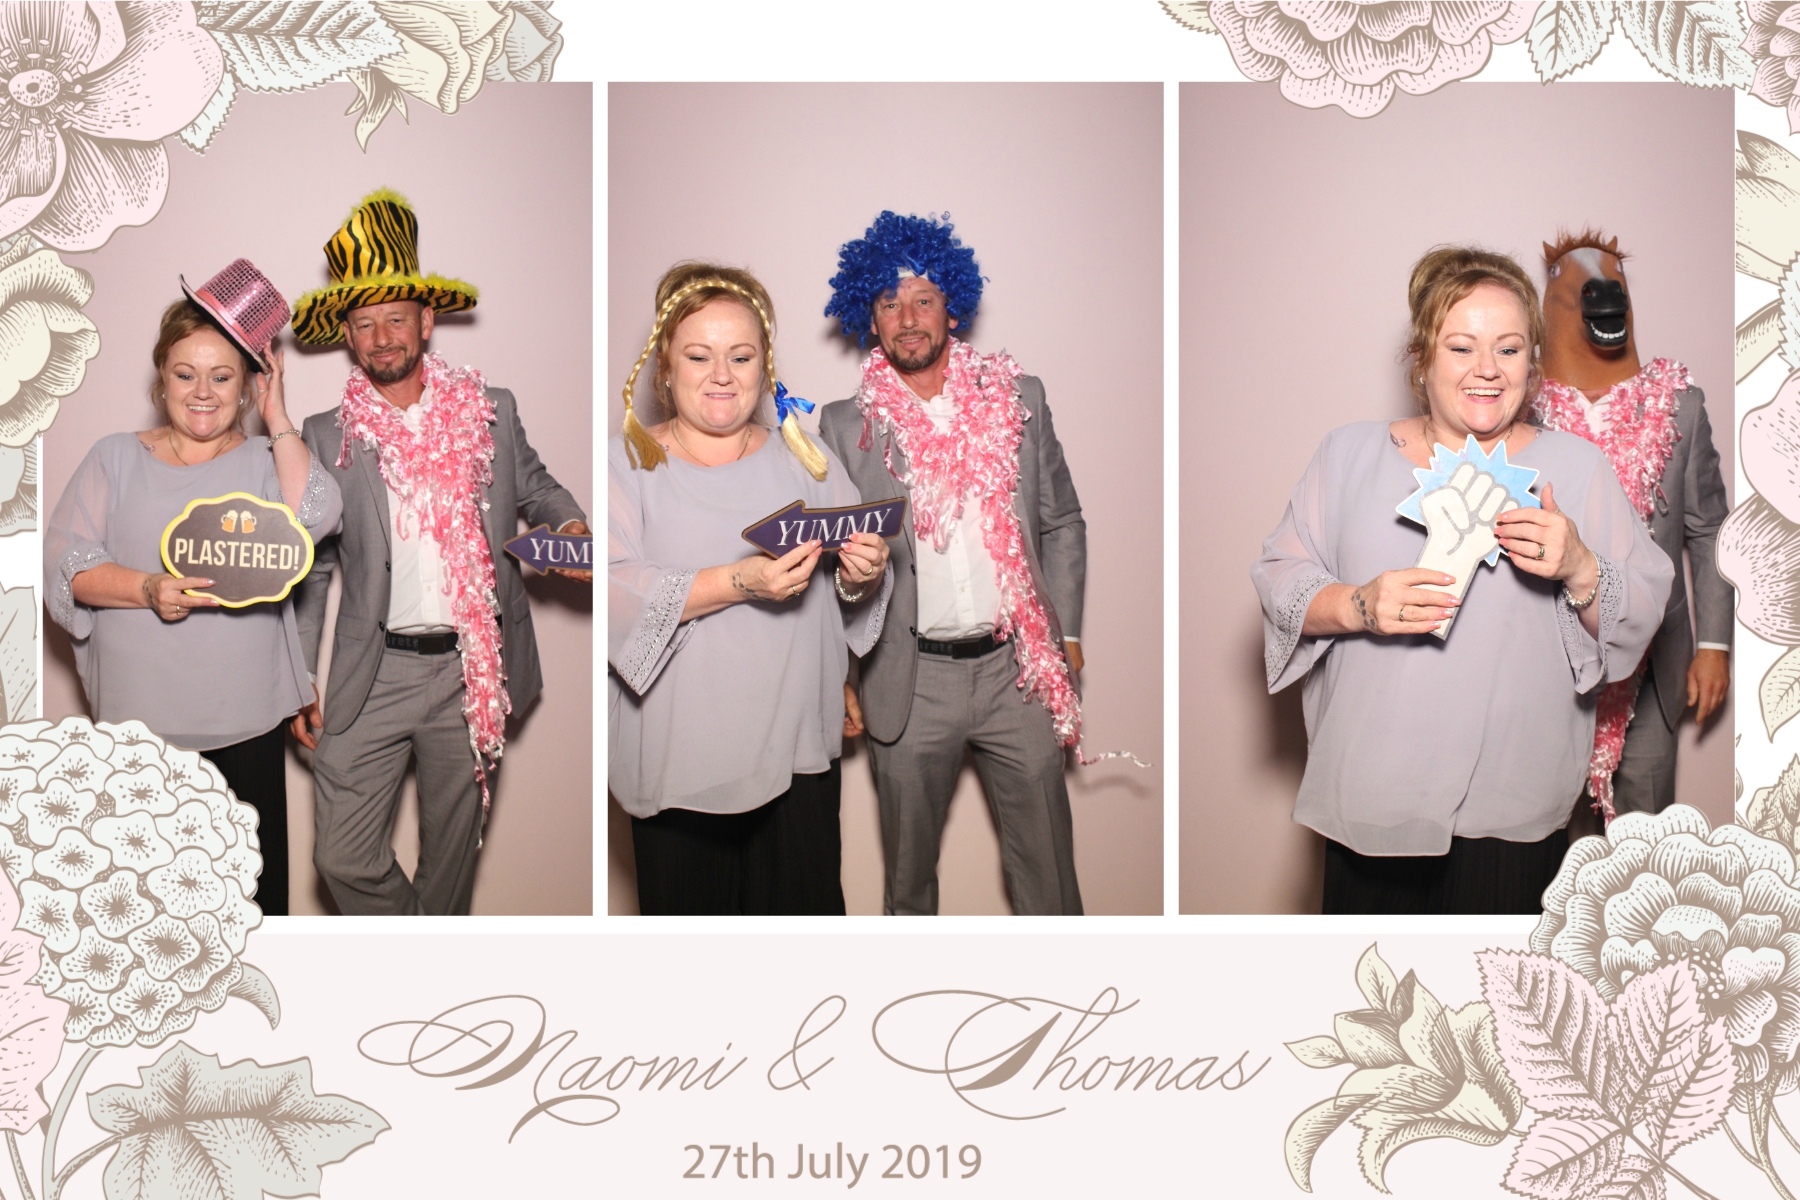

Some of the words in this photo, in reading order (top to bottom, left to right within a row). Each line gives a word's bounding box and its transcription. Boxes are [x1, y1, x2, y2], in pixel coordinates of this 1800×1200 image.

[777, 508, 892, 546] YUMMY
[174, 538, 300, 571] PLASTERED!
[530, 537, 593, 564] YUM
